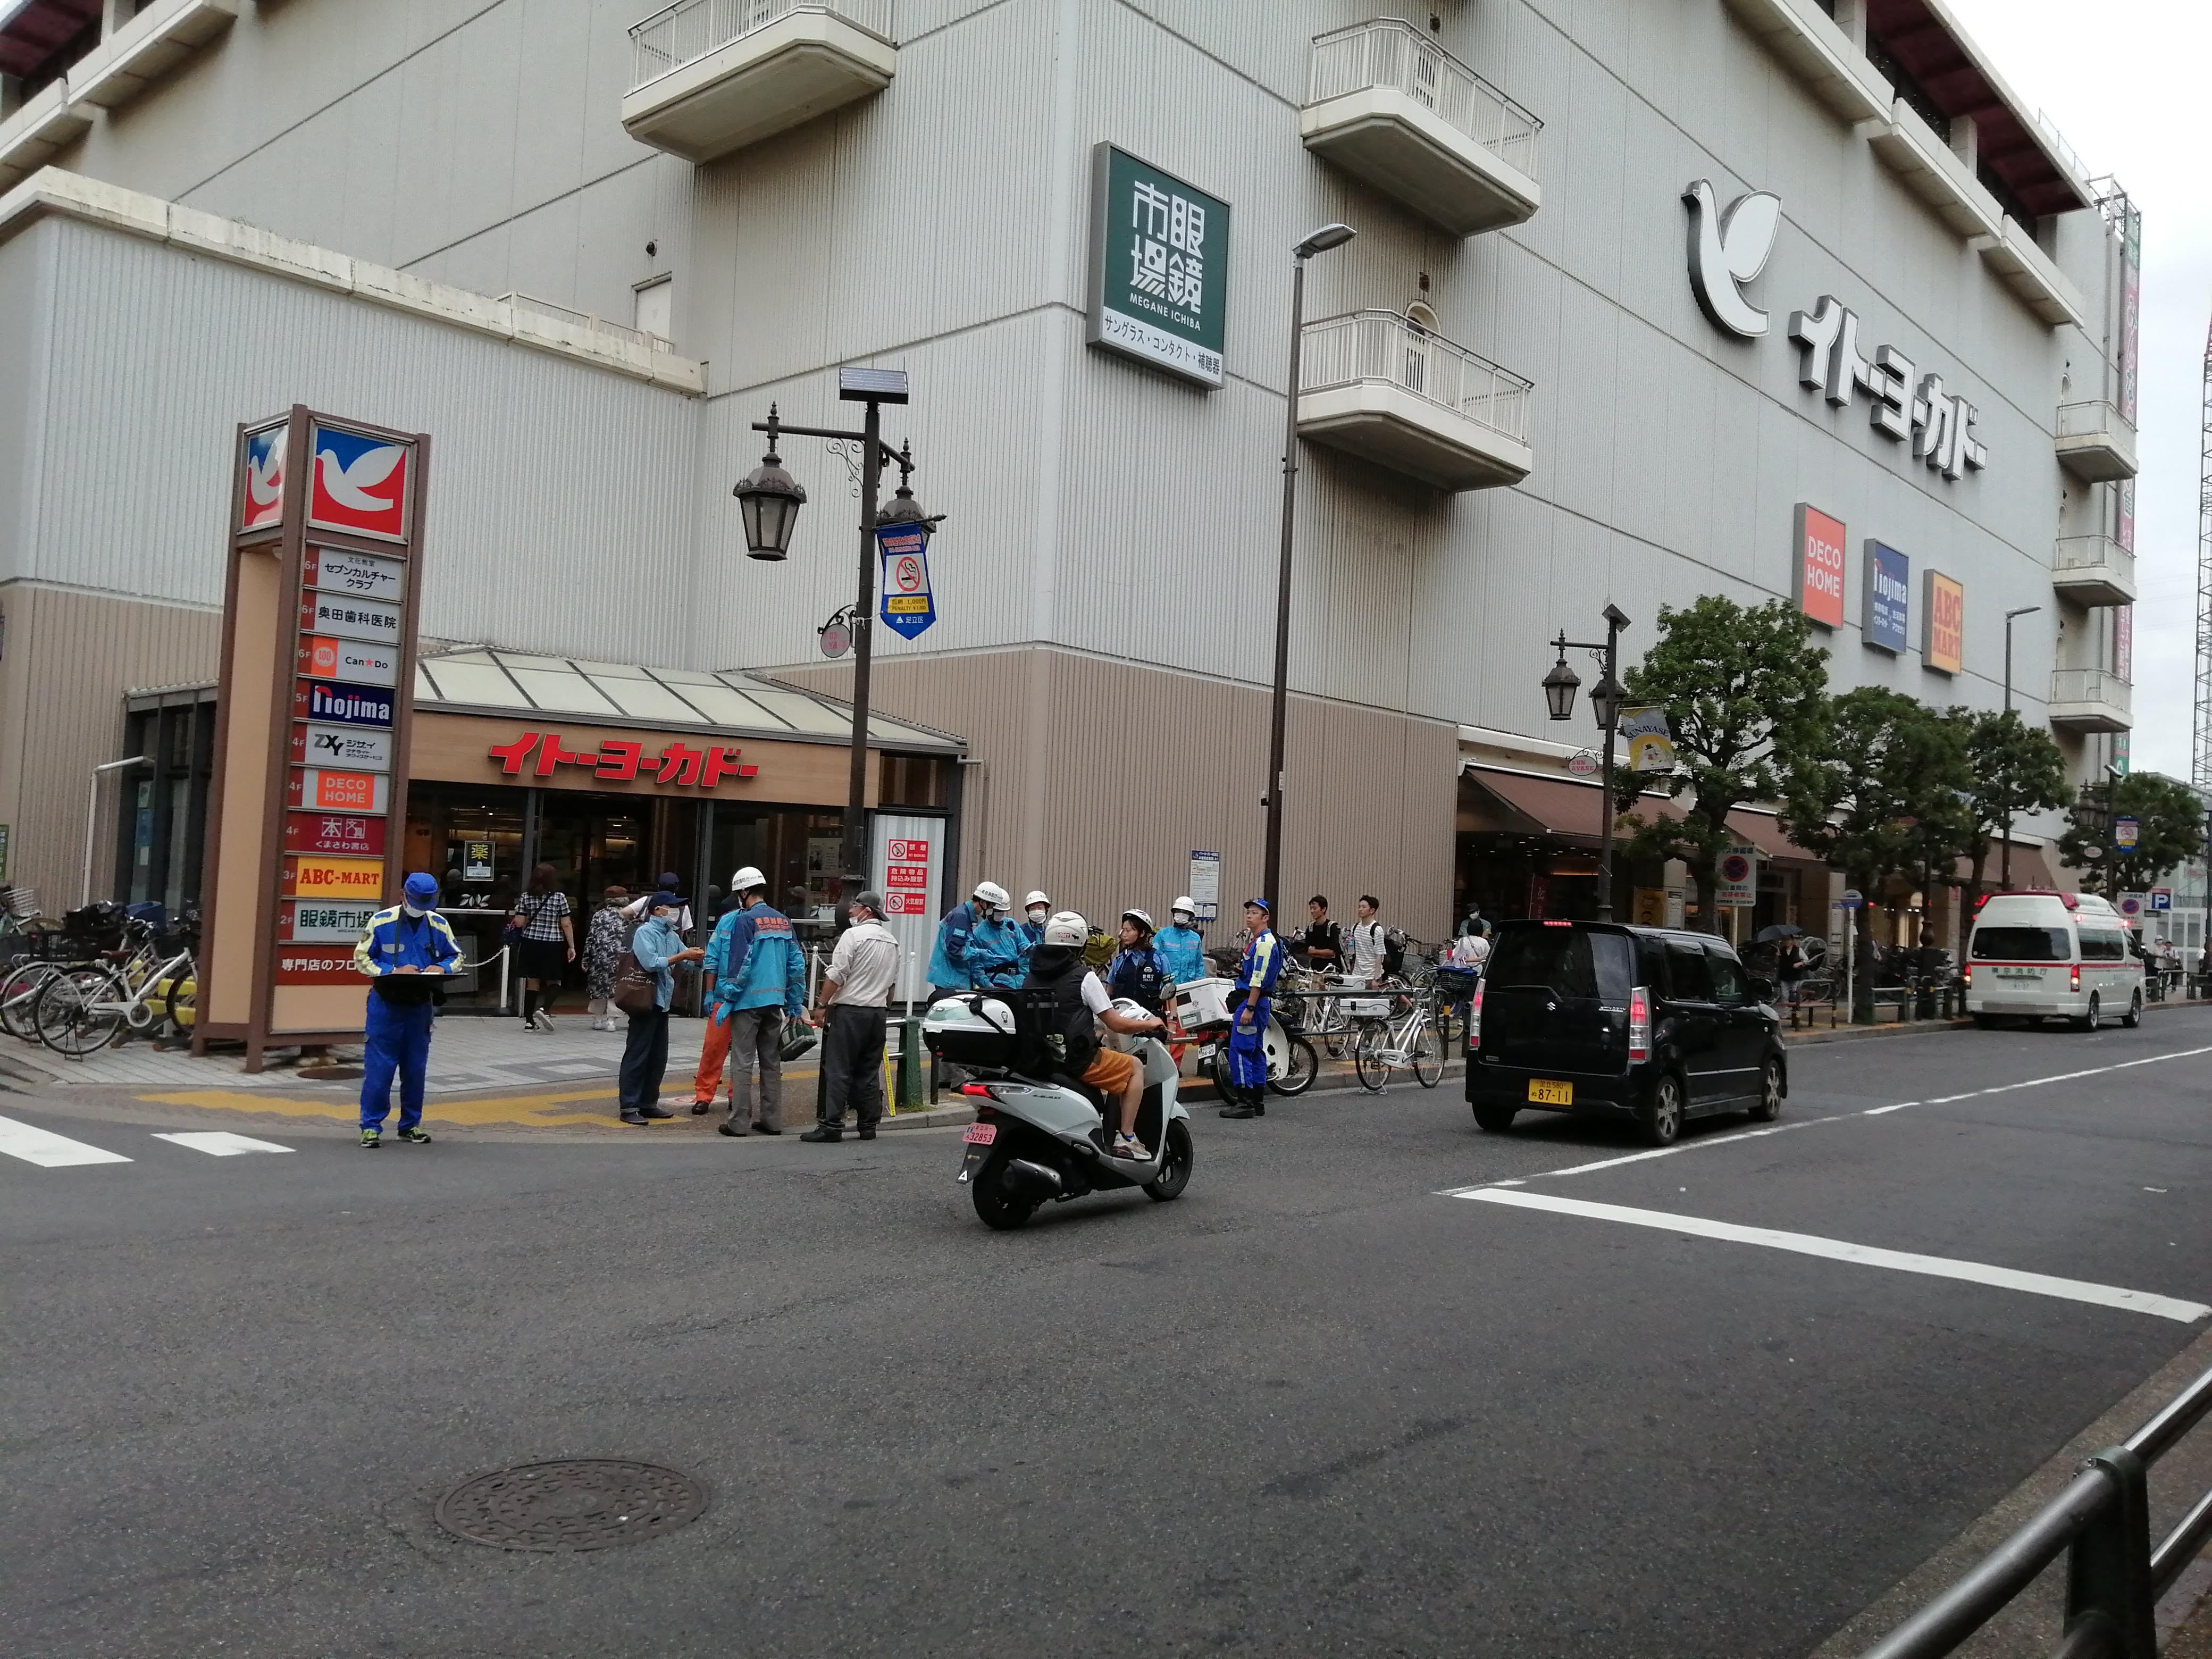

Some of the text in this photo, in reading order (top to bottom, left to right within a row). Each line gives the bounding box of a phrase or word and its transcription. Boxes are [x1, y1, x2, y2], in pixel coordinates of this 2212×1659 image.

[1168, 195, 1205, 314] 眼鏡
[1130, 292, 1201, 331] MEGANE ICHIBA
[1104, 314, 1220, 375] サングラス・コンタクト・補聴器
[1789, 295, 1988, 480] イトーヨーカドー
[1808, 535, 1841, 569] DECO
[325, 563, 396, 582] セブンカルチャー
[1807, 564, 1840, 598] HOME
[347, 578, 373, 590] クラブ
[1874, 558, 1906, 605] nojima
[301, 606, 314, 614] 6F
[319, 606, 397, 629] 奥田歯科医院
[1933, 586, 1960, 633] ABC
[1933, 626, 1960, 661] MART
[299, 649, 311, 658] 6F
[296, 693, 308, 702] 5F
[313, 685, 390, 720] nojima
[1627, 725, 1669, 740] SUNAYASE
[292, 738, 305, 747] 4F
[314, 734, 344, 756] ZXY
[489, 732, 759, 787] イトーヨーカドー
[289, 782, 302, 791] 4F
[326, 777, 366, 790] DECO
[325, 792, 366, 803] HOME
[286, 826, 298, 835] 4F
[321, 817, 342, 838] 本
[471, 844, 488, 859] 薬
[283, 870, 295, 879] 3F
[300, 868, 379, 885] ABC-MART
[2155, 894, 2169, 908] P
[280, 915, 292, 924] 2F
[300, 909, 374, 928] 眼鏡市場
[1538, 1088, 1568, 1102] 87-11
[969, 1132, 992, 1143] 32853
